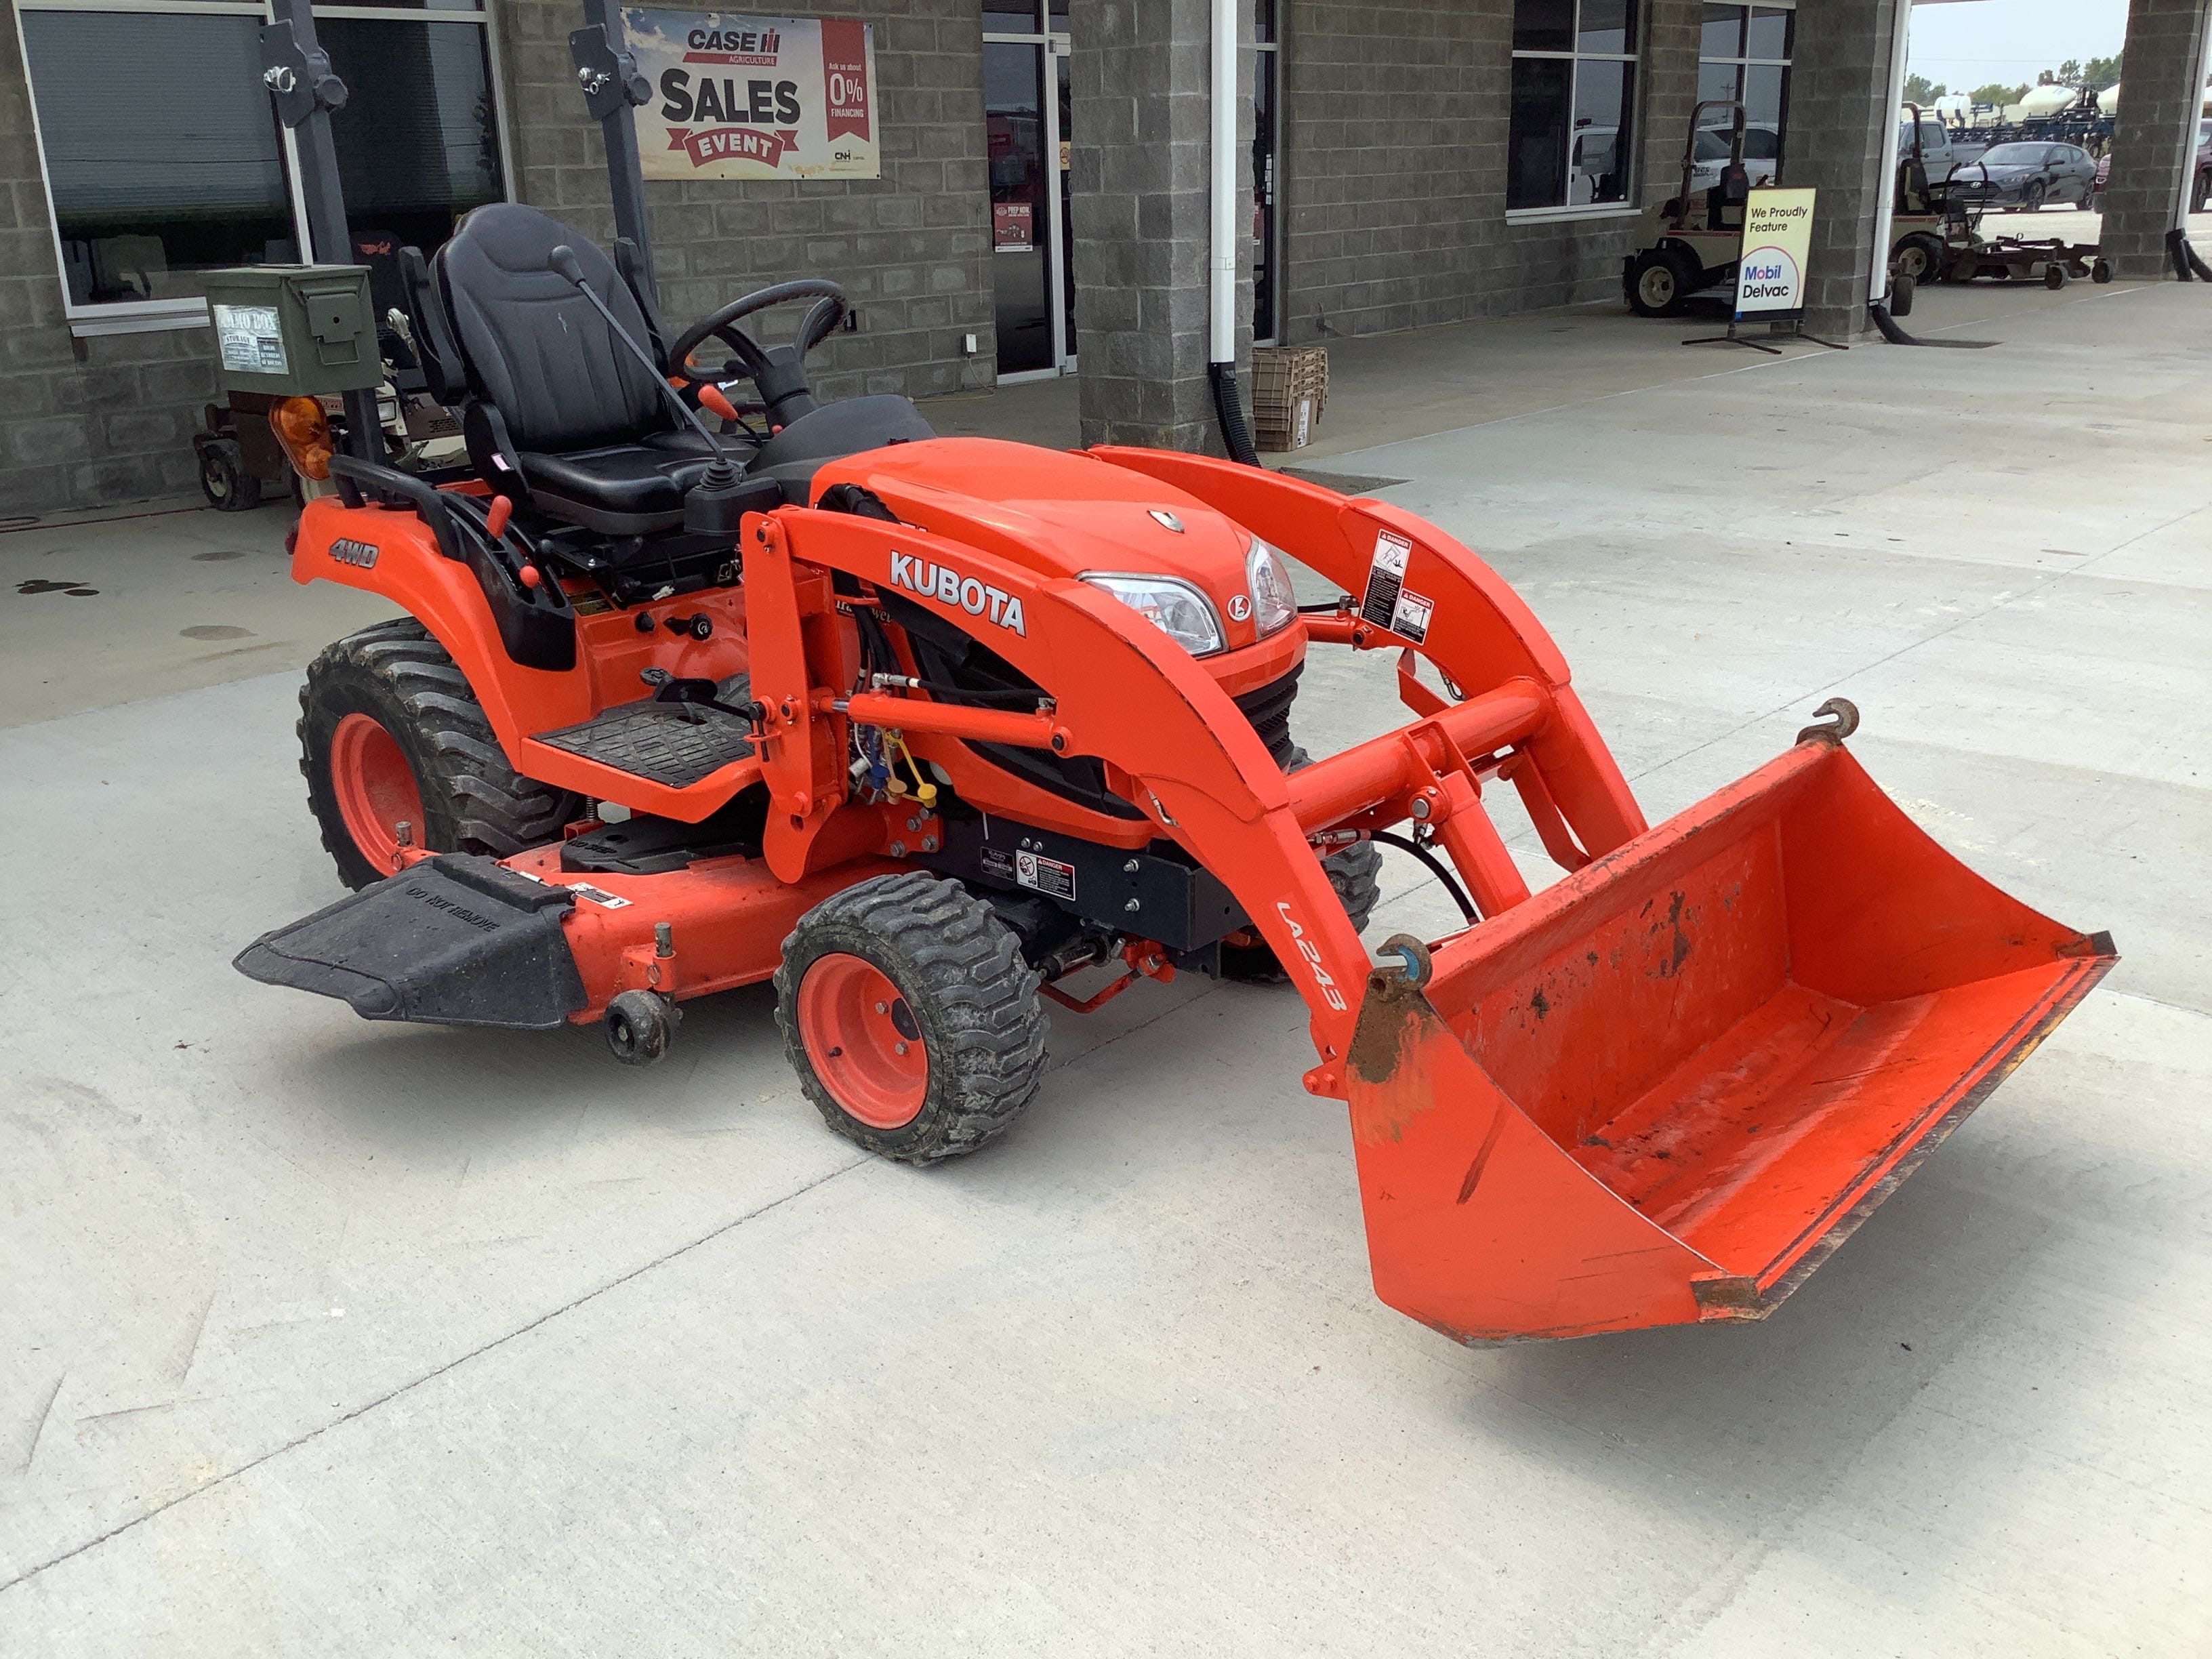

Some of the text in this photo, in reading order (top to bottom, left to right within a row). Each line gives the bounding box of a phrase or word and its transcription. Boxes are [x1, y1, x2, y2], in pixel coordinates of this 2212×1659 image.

[688, 29, 757, 52] CASE
[729, 56, 775, 65] AGRICULTURE
[829, 62, 839, 70] Ask
[660, 68, 800, 125] SALES
[830, 73, 863, 106] 0%
[831, 108, 864, 118] FINANCING
[697, 134, 773, 157] EVENT
[1751, 206, 1808, 219] We Proudly
[1750, 222, 1788, 232] Feature
[1744, 265, 1782, 281] Mobil
[1742, 284, 1789, 298] Delvac
[1387, 535, 1409, 548] DANGER
[329, 537, 379, 569] 4WD
[890, 550, 1027, 639] KUBOTA
[1409, 593, 1431, 608] DANGER
[1042, 860, 1063, 871] DANGER
[407, 887, 500, 932] DO NOT REMOVE
[1277, 902, 1347, 1010] LA243
